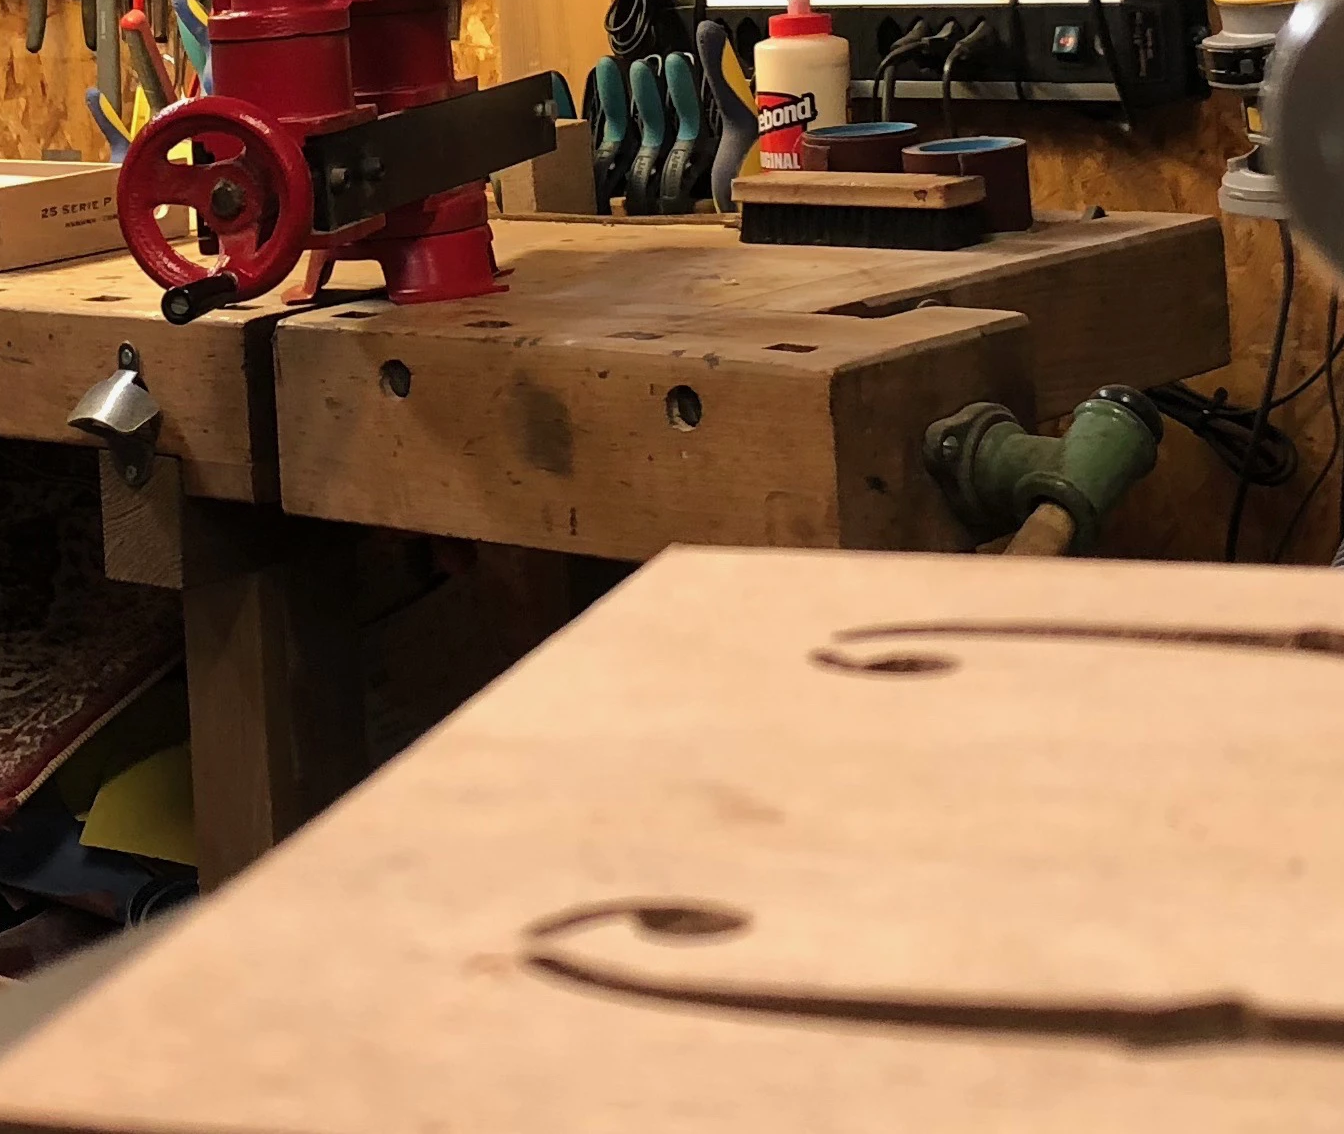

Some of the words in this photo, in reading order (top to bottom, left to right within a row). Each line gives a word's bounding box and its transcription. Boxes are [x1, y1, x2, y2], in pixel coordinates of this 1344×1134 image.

[757, 96, 812, 134] ebond
[40, 206, 58, 219] 25
[62, 200, 100, 216] SERIE
[103, 196, 112, 207] P
